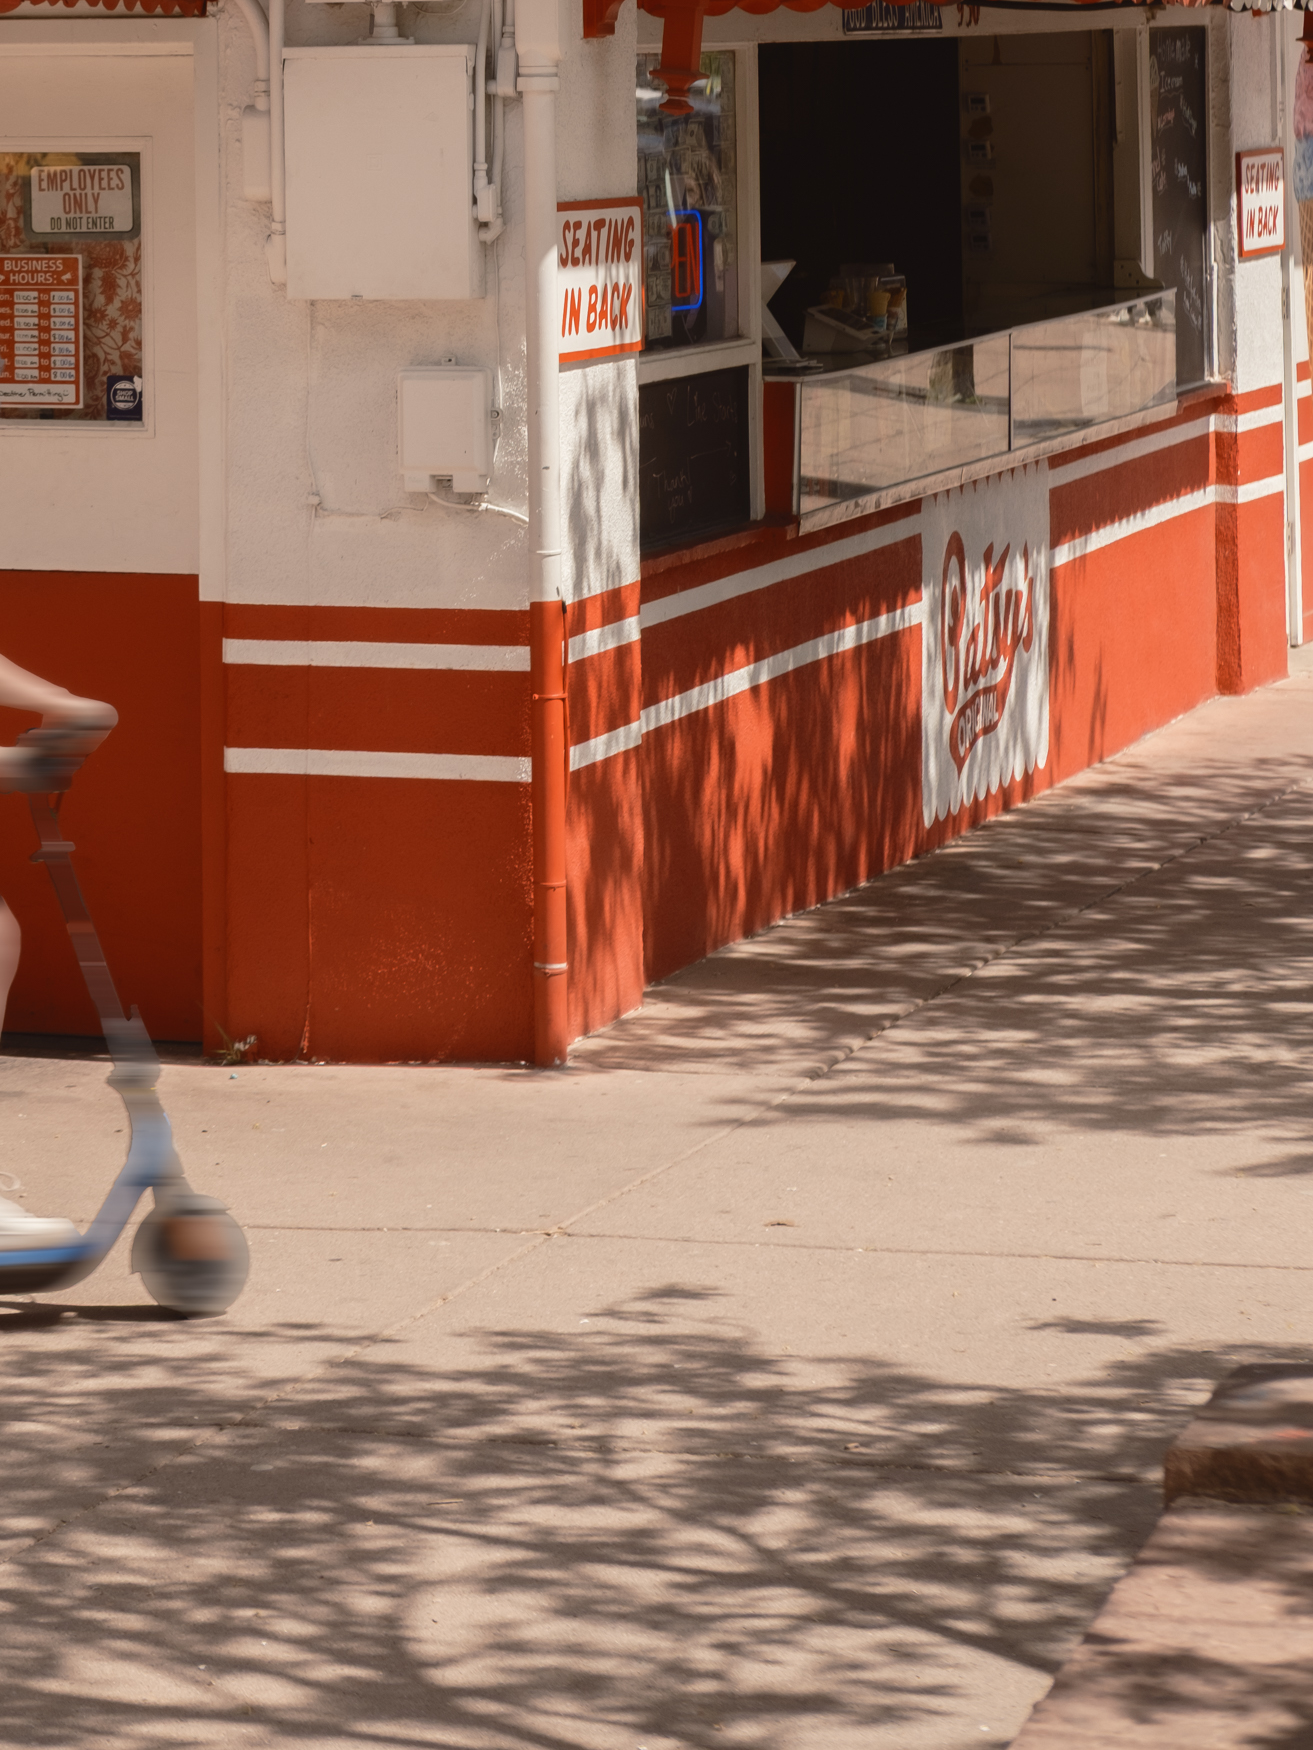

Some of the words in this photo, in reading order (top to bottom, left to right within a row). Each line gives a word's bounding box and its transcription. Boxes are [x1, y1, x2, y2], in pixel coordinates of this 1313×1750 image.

[38, 168, 125, 192] EMPLOYEES
[1245, 161, 1280, 194] SEATING
[62, 192, 101, 215] ONLY
[50, 217, 62, 231] DO
[65, 217, 84, 231] NOT
[86, 216, 115, 230] ENTER
[1246, 208, 1256, 239] IN
[1258, 205, 1279, 238] BACK
[560, 215, 635, 268] SEATING
[4, 260, 63, 271] BUSINESS
[10, 273, 57, 284] HOURS:
[562, 287, 582, 338] IN
[586, 282, 633, 333] BACK
[941, 531, 1034, 715] Patsy's
[958, 691, 999, 757] ORIGINAL
